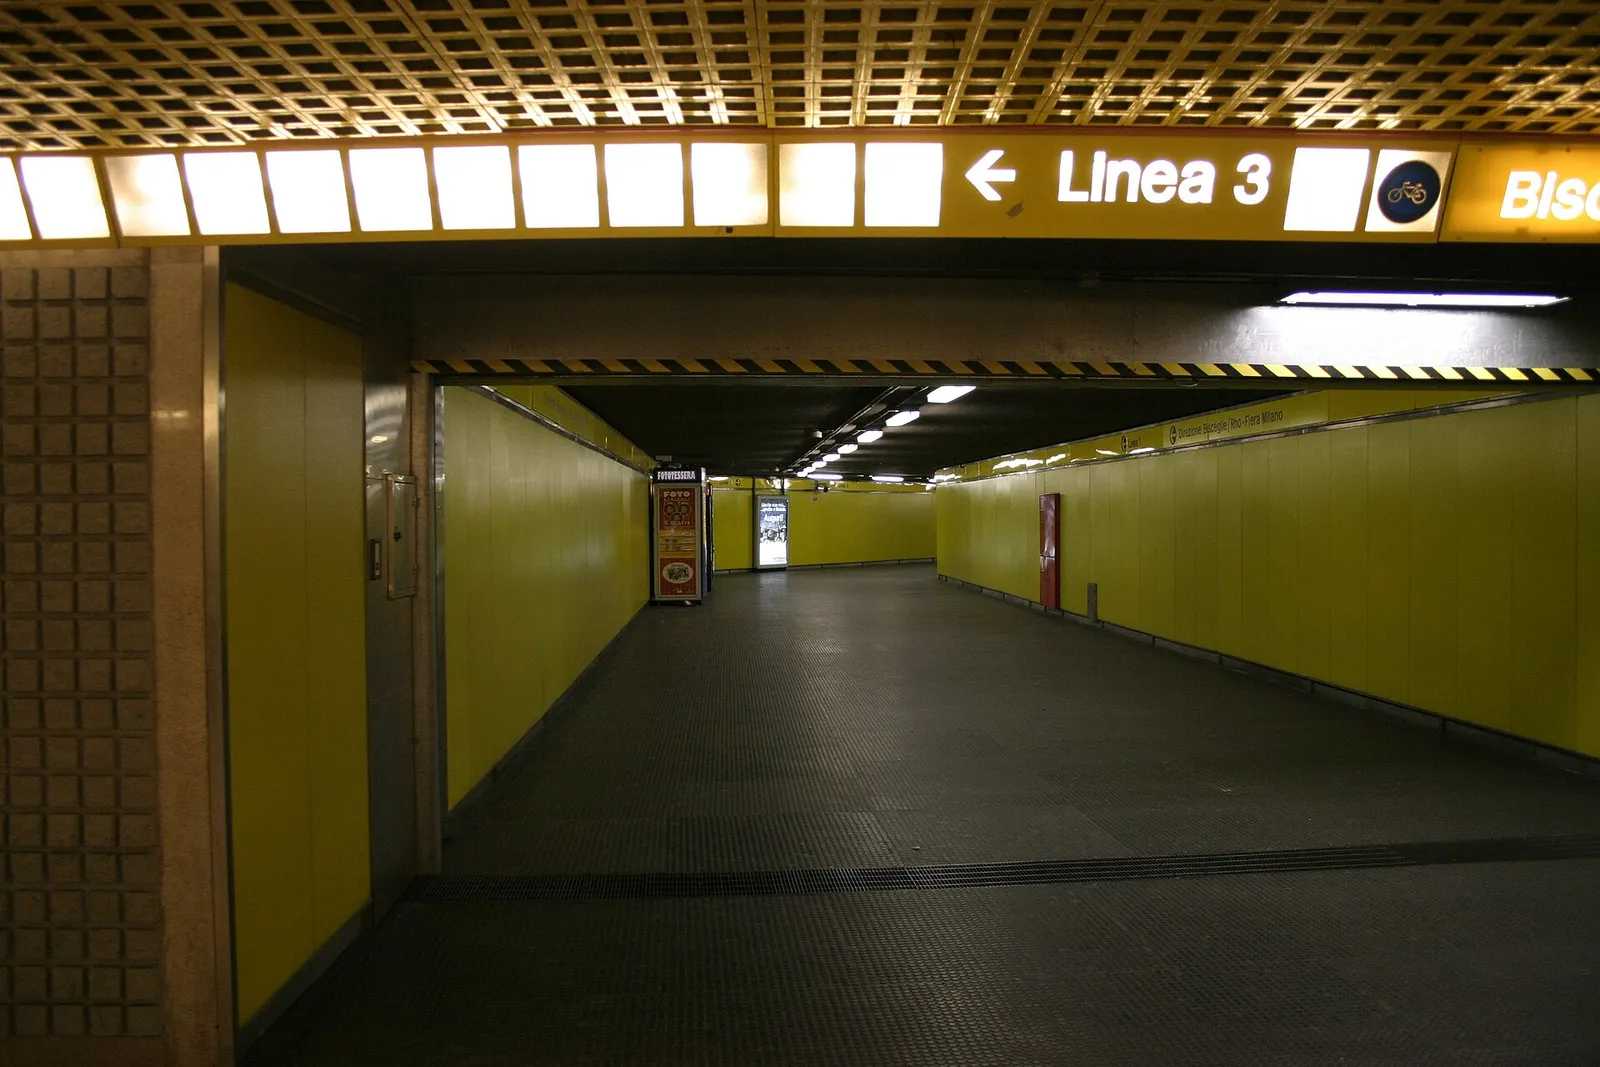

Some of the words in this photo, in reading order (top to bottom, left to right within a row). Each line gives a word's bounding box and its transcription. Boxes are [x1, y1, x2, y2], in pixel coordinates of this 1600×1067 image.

[1057, 150, 1216, 204] Linea
[1233, 153, 1272, 205] 3
[1178, 425, 1202, 439] Direzione
[1261, 410, 1284, 425] Milano
[657, 470, 696, 480] FOTOTESSERA
